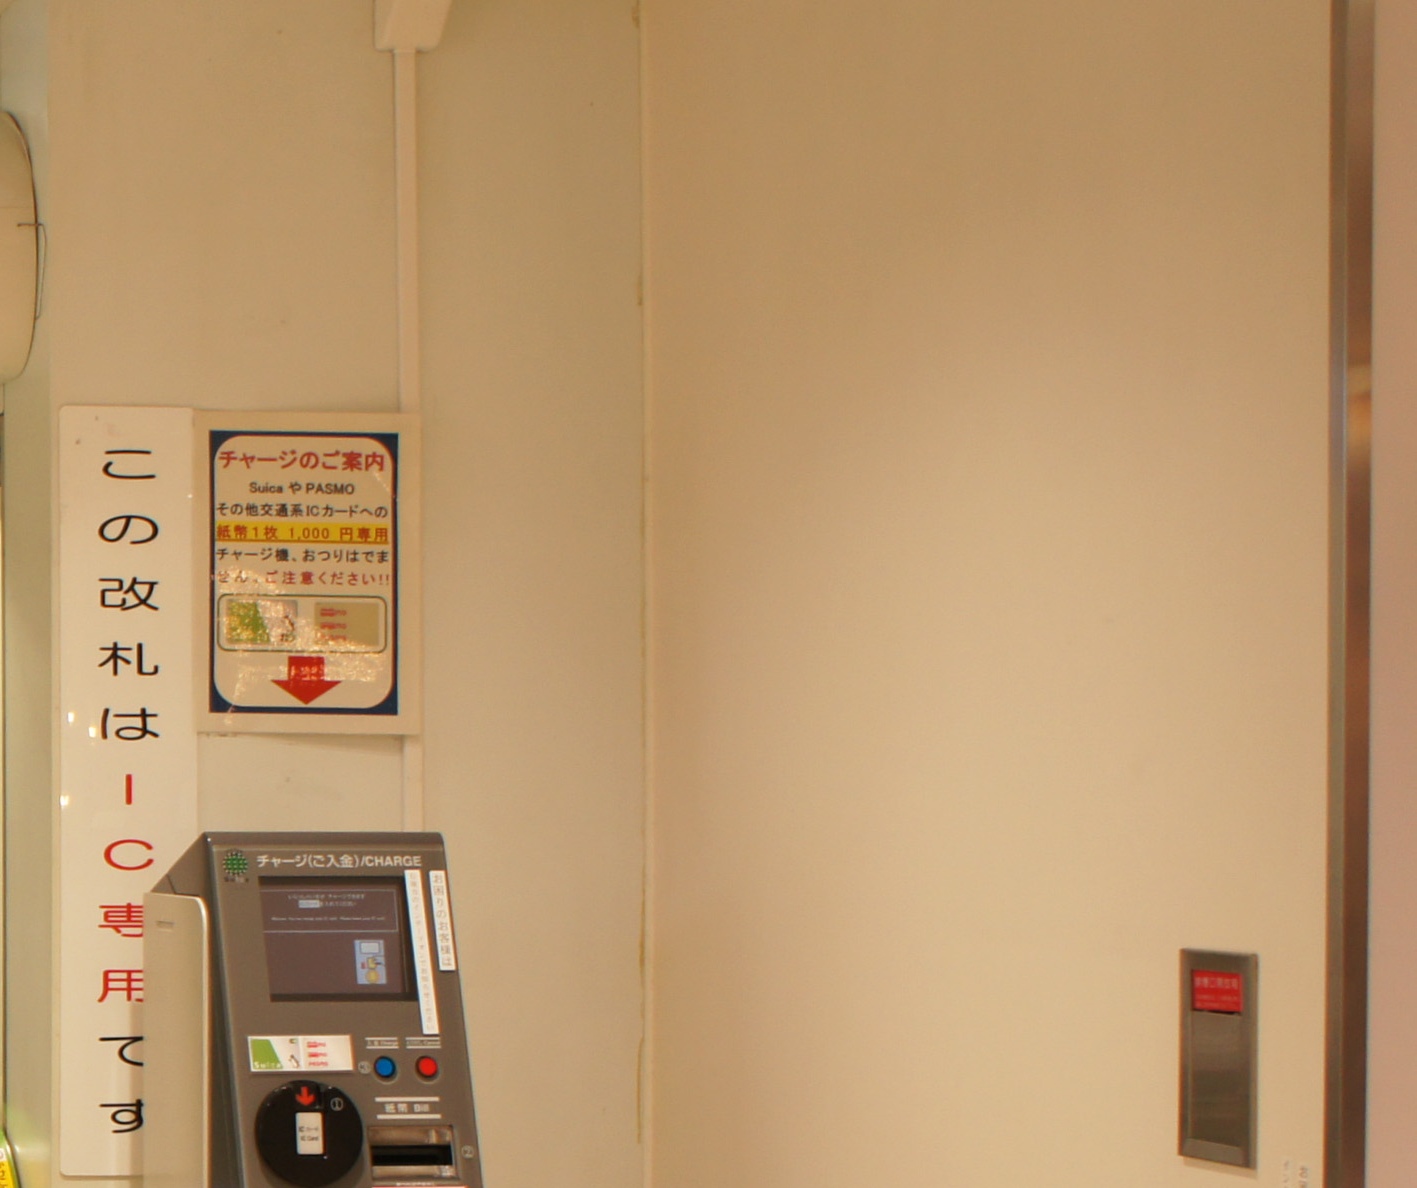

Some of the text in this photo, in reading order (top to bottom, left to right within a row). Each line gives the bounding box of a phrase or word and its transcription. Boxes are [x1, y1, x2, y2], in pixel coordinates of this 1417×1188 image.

[218, 450, 385, 472] チャージのご案内
[249, 482, 283, 494] Suica
[306, 483, 355, 495] PASMO
[217, 503, 388, 518] その他交通系ICカードへの
[216, 548, 390, 563] チャージ機、おつりはでま
[257, 854, 422, 868] チャージ(ご入金)/CHARGE
[432, 873, 453, 967] お困りのお客様は
